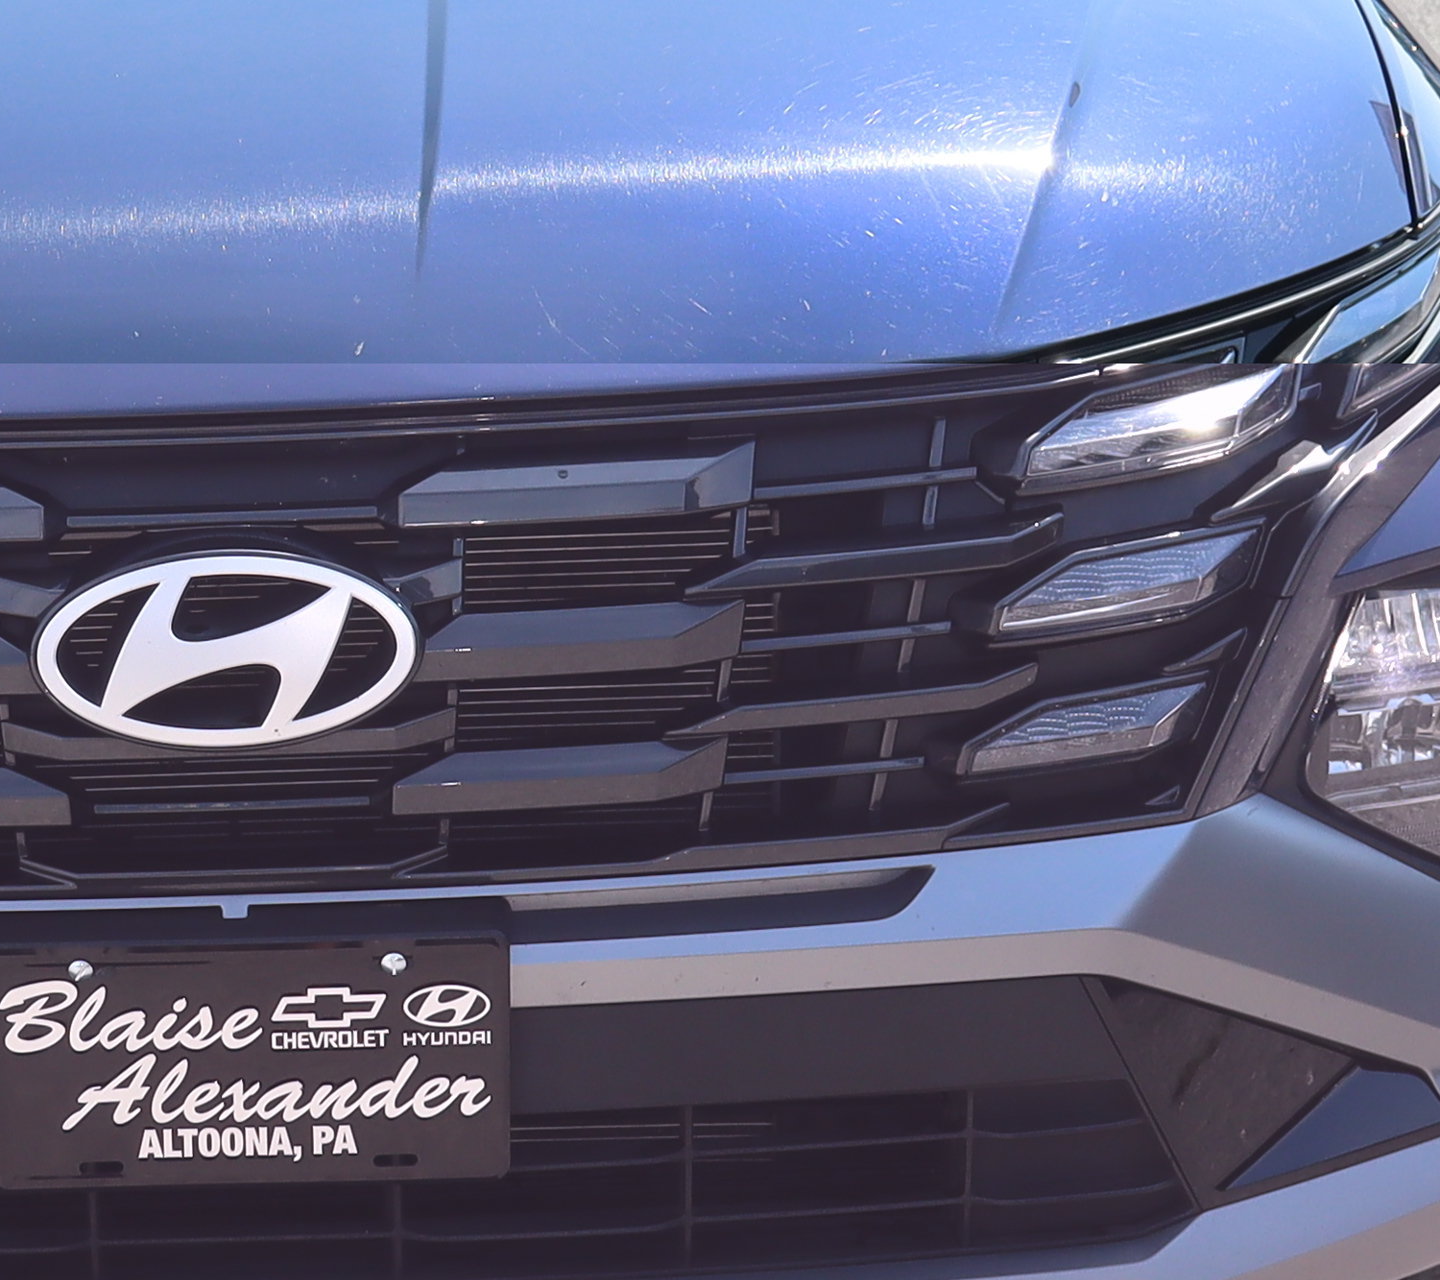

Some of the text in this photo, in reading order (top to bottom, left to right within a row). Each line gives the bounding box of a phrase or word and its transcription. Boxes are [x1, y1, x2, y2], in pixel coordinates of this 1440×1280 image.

[271, 1028, 389, 1051] CHEVROLET
[402, 1029, 492, 1046] HYUNDAI
[61, 1054, 493, 1132] Alexander
[137, 1125, 358, 1162] ALTOONA, PA
